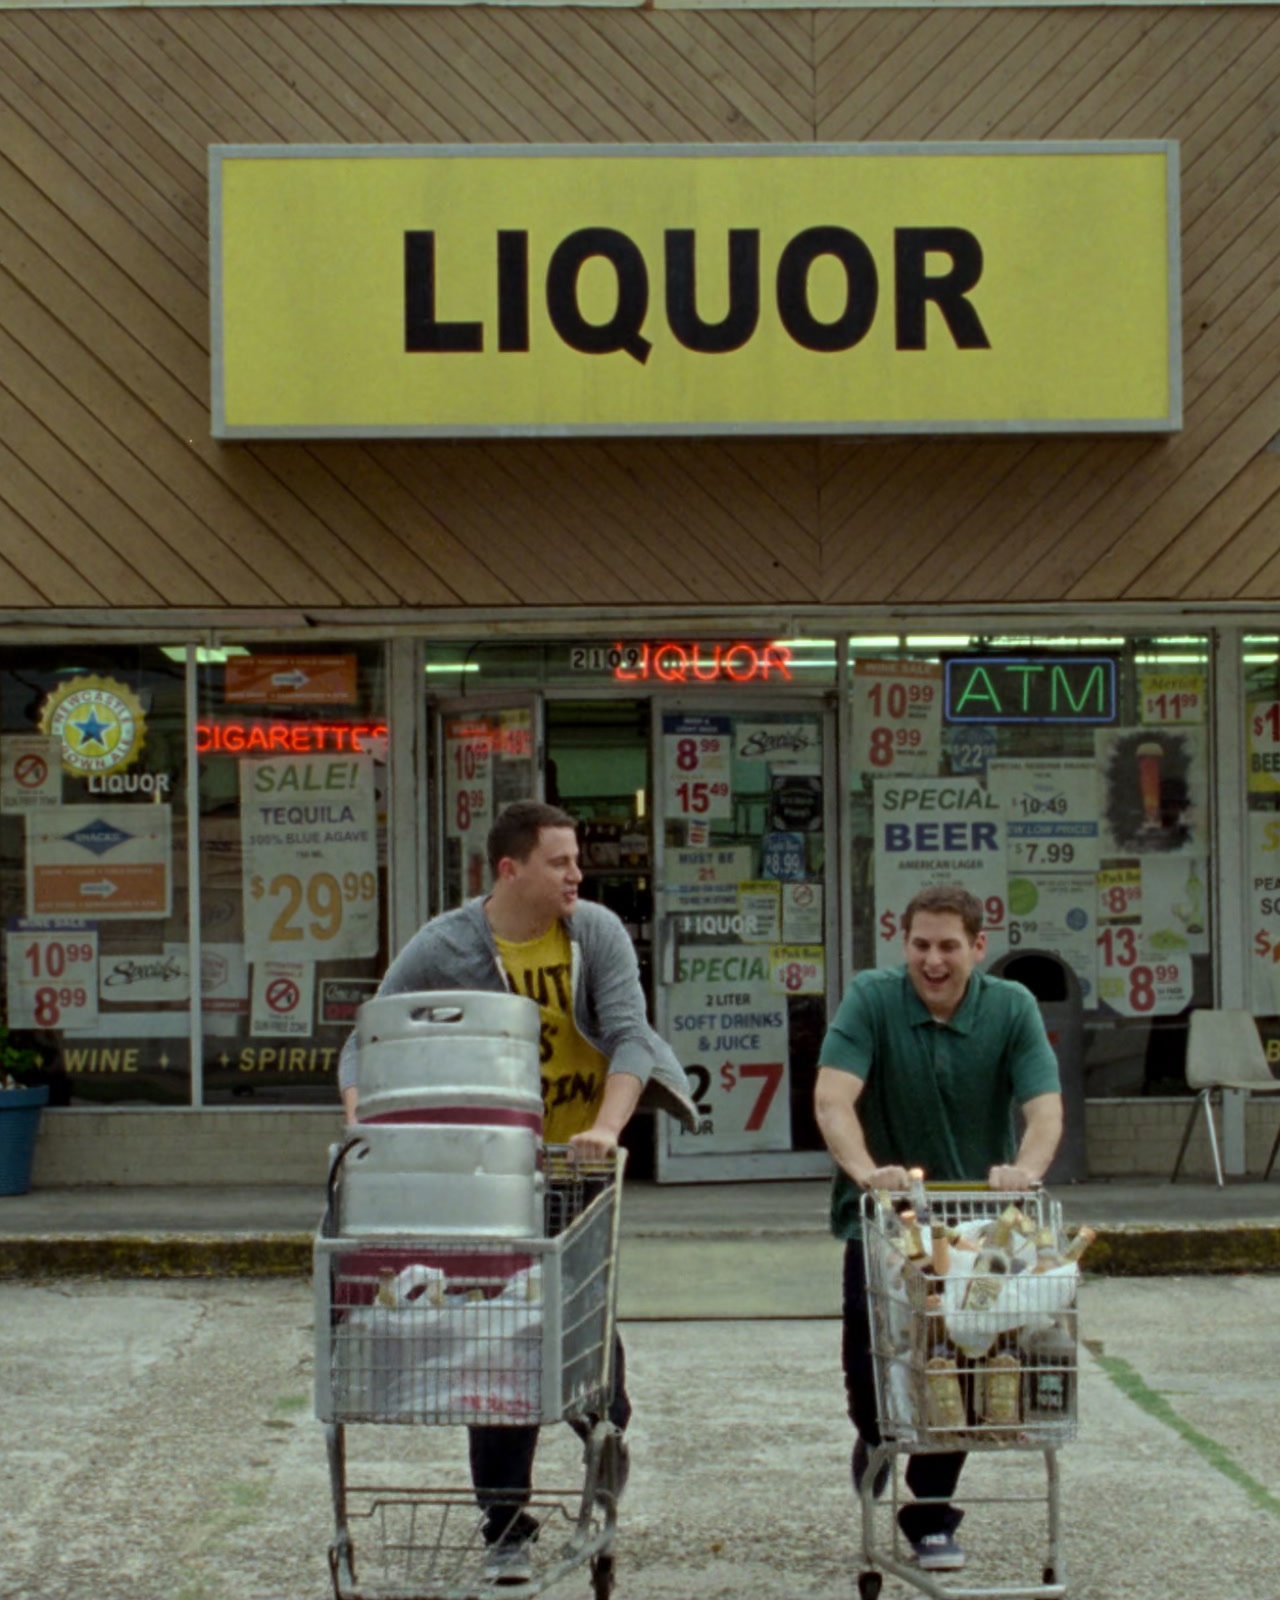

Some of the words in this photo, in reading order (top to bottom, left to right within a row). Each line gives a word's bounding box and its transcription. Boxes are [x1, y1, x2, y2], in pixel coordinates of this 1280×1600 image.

[402, 225, 993, 366] LIQUOR
[573, 650, 640, 669] 2109
[613, 642, 794, 681] LIQUOR
[955, 666, 1104, 713] ATM
[88, 774, 170, 794] LIQUOR
[254, 762, 360, 793] SALE!
[883, 788, 1001, 811] SPECIAL
[259, 806, 355, 826] TEQUILA
[885, 822, 1000, 853] BEER
[1007, 823, 1026, 835] EW
[679, 852, 713, 865] MUST
[718, 852, 734, 864] BE
[899, 860, 950, 871] AMERICAN
[953, 859, 984, 870] LAGER
[677, 958, 770, 984] SPECIA
[716, 993, 751, 1007] LITER
[674, 1014, 717, 1033] SOFT
[721, 1011, 783, 1031] DRINKS
[698, 1036, 712, 1053] &
[714, 1034, 761, 1052] JUICE
[64, 1047, 140, 1073] WINE
[239, 1047, 339, 1073] SPIRIT
[684, 1063, 712, 1116] 2
[719, 1060, 784, 1132] $7
